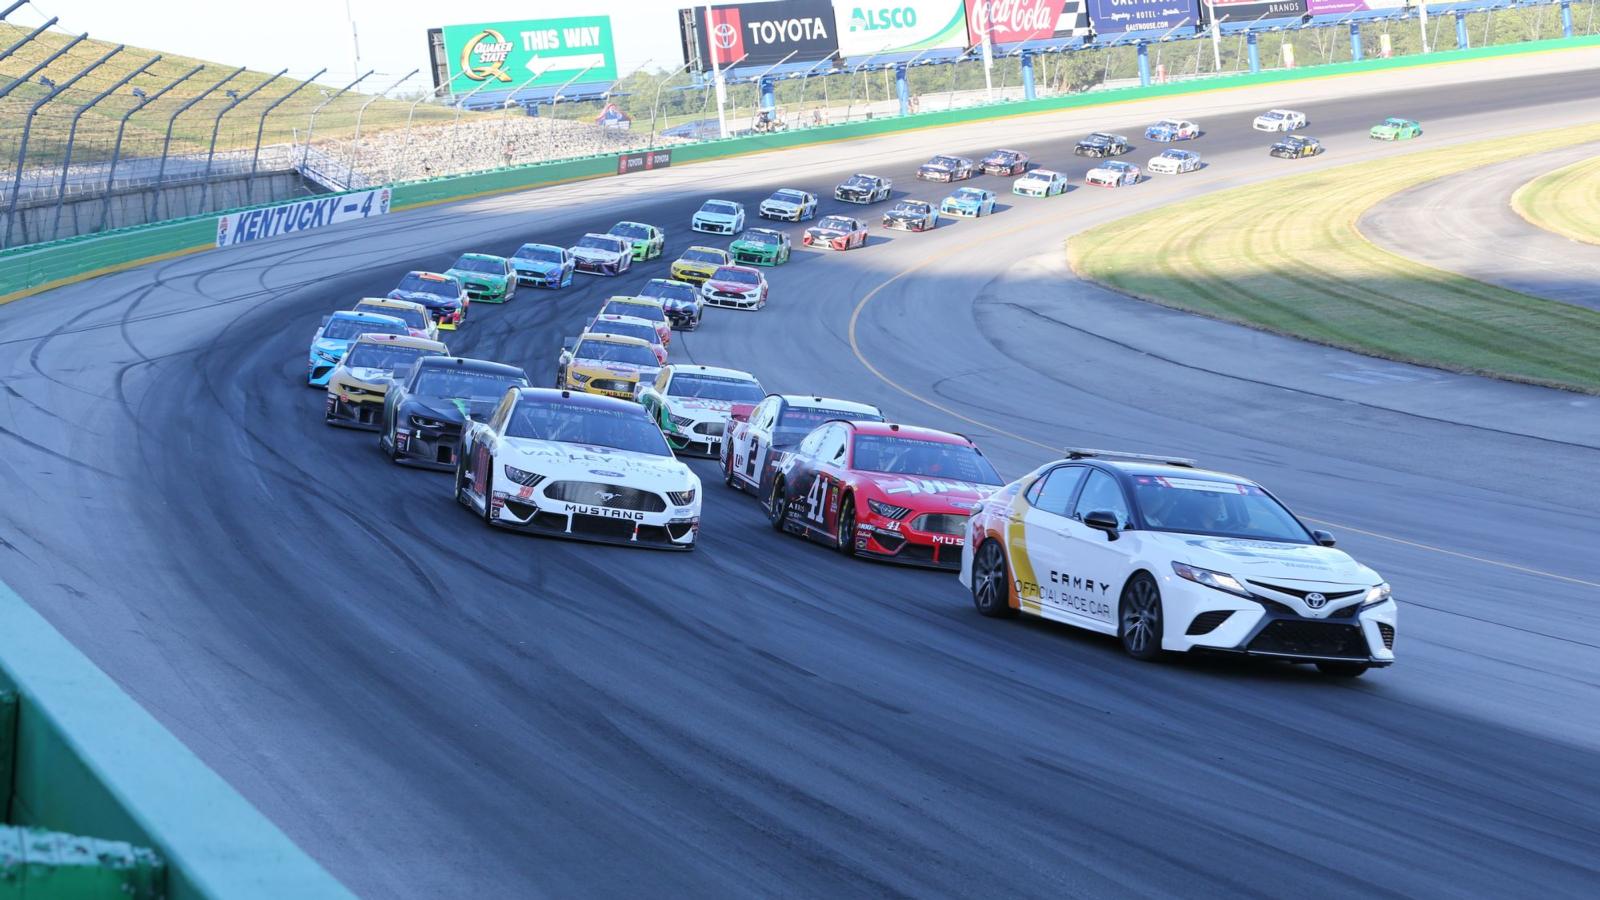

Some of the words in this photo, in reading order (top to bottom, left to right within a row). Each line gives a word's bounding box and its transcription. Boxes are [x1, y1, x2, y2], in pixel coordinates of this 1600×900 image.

[1268, 3, 1299, 13] BRANDS
[849, 7, 916, 32] ALSCO
[520, 29, 560, 51] THIS
[563, 26, 600, 48] WAY
[748, 18, 828, 44] TOYOTA
[473, 41, 514, 54] QUAKER
[479, 52, 507, 63] STATE
[627, 158, 643, 168] TOYOTA
[653, 154, 669, 164] TOYOTA
[806, 473, 829, 524] 41
[564, 502, 645, 521] MUSTANG
[886, 520, 901, 531] 41
[1050, 570, 1111, 596] CAMRY
[1014, 579, 1060, 605] OFFICIAL
[1061, 592, 1088, 613] PACE
[1088, 600, 1111, 618] CAR
